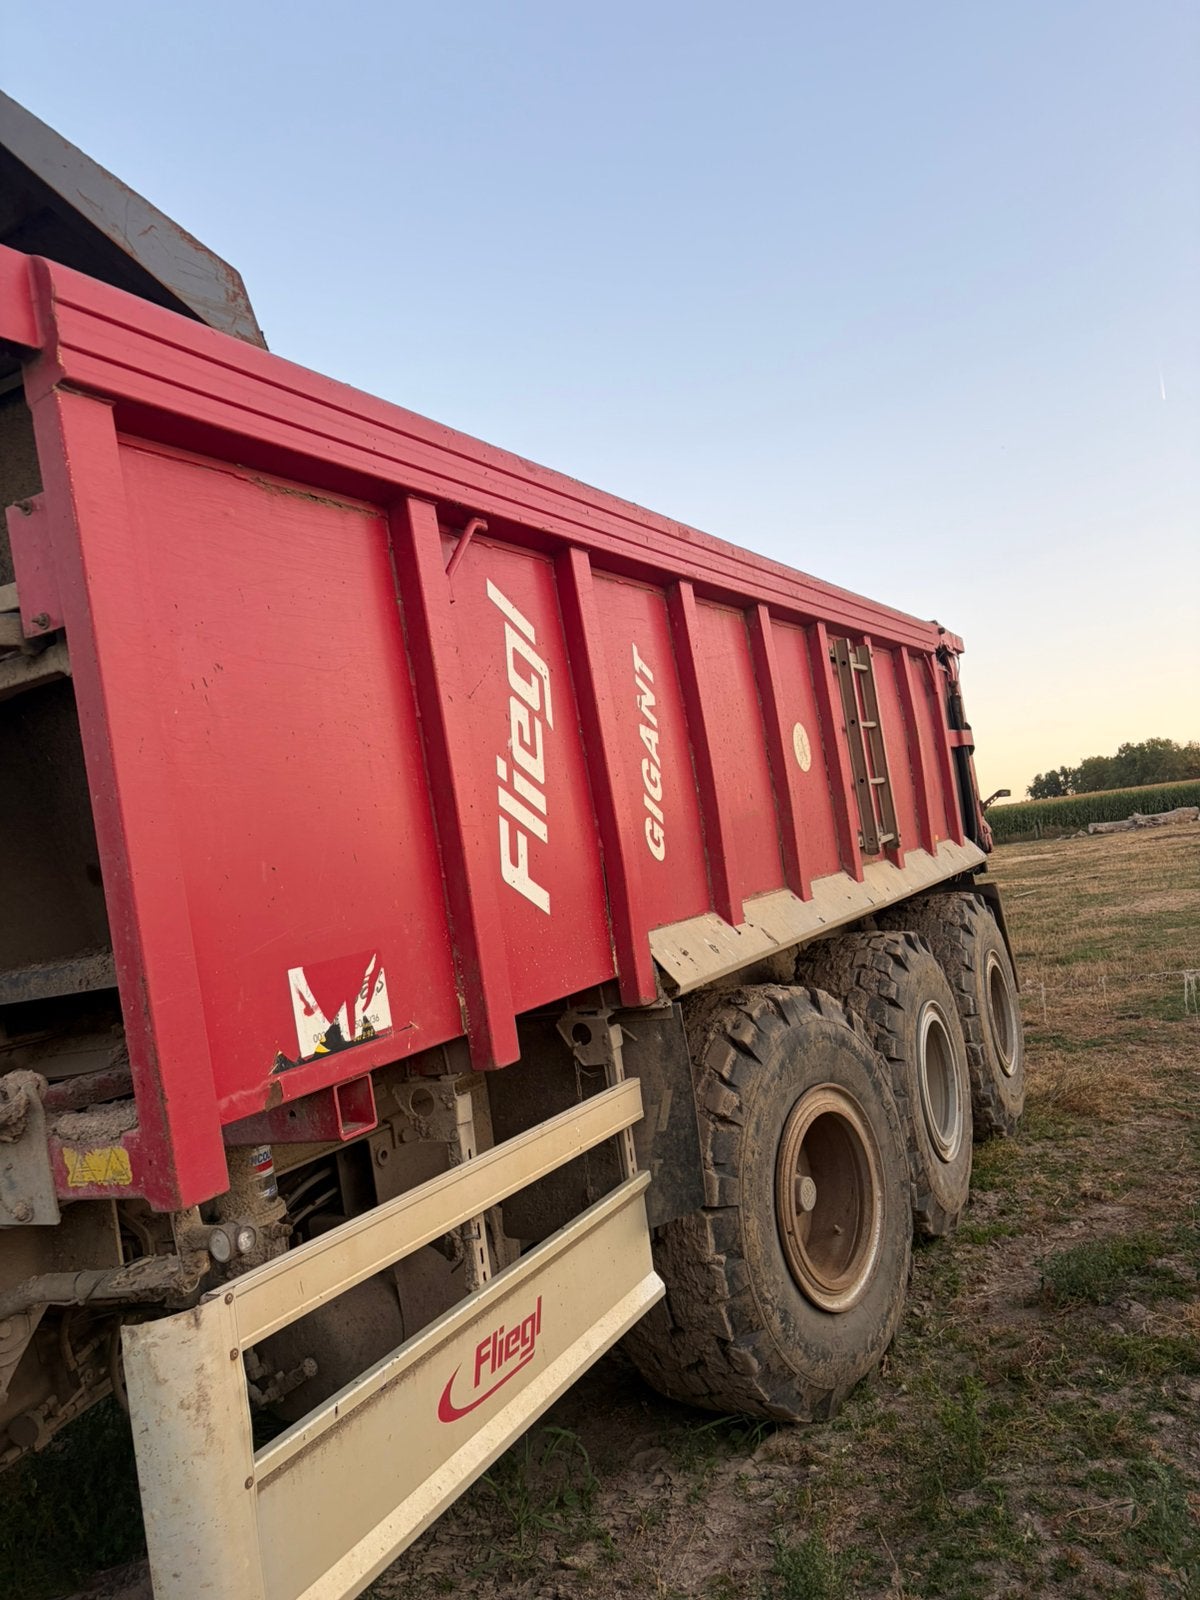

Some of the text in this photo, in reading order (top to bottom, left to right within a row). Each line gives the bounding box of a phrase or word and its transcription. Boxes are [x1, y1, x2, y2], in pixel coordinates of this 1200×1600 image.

[486, 577, 554, 915] Fliegl
[632, 642, 665, 861] GIGANT
[473, 1294, 542, 1389] Fliegl
